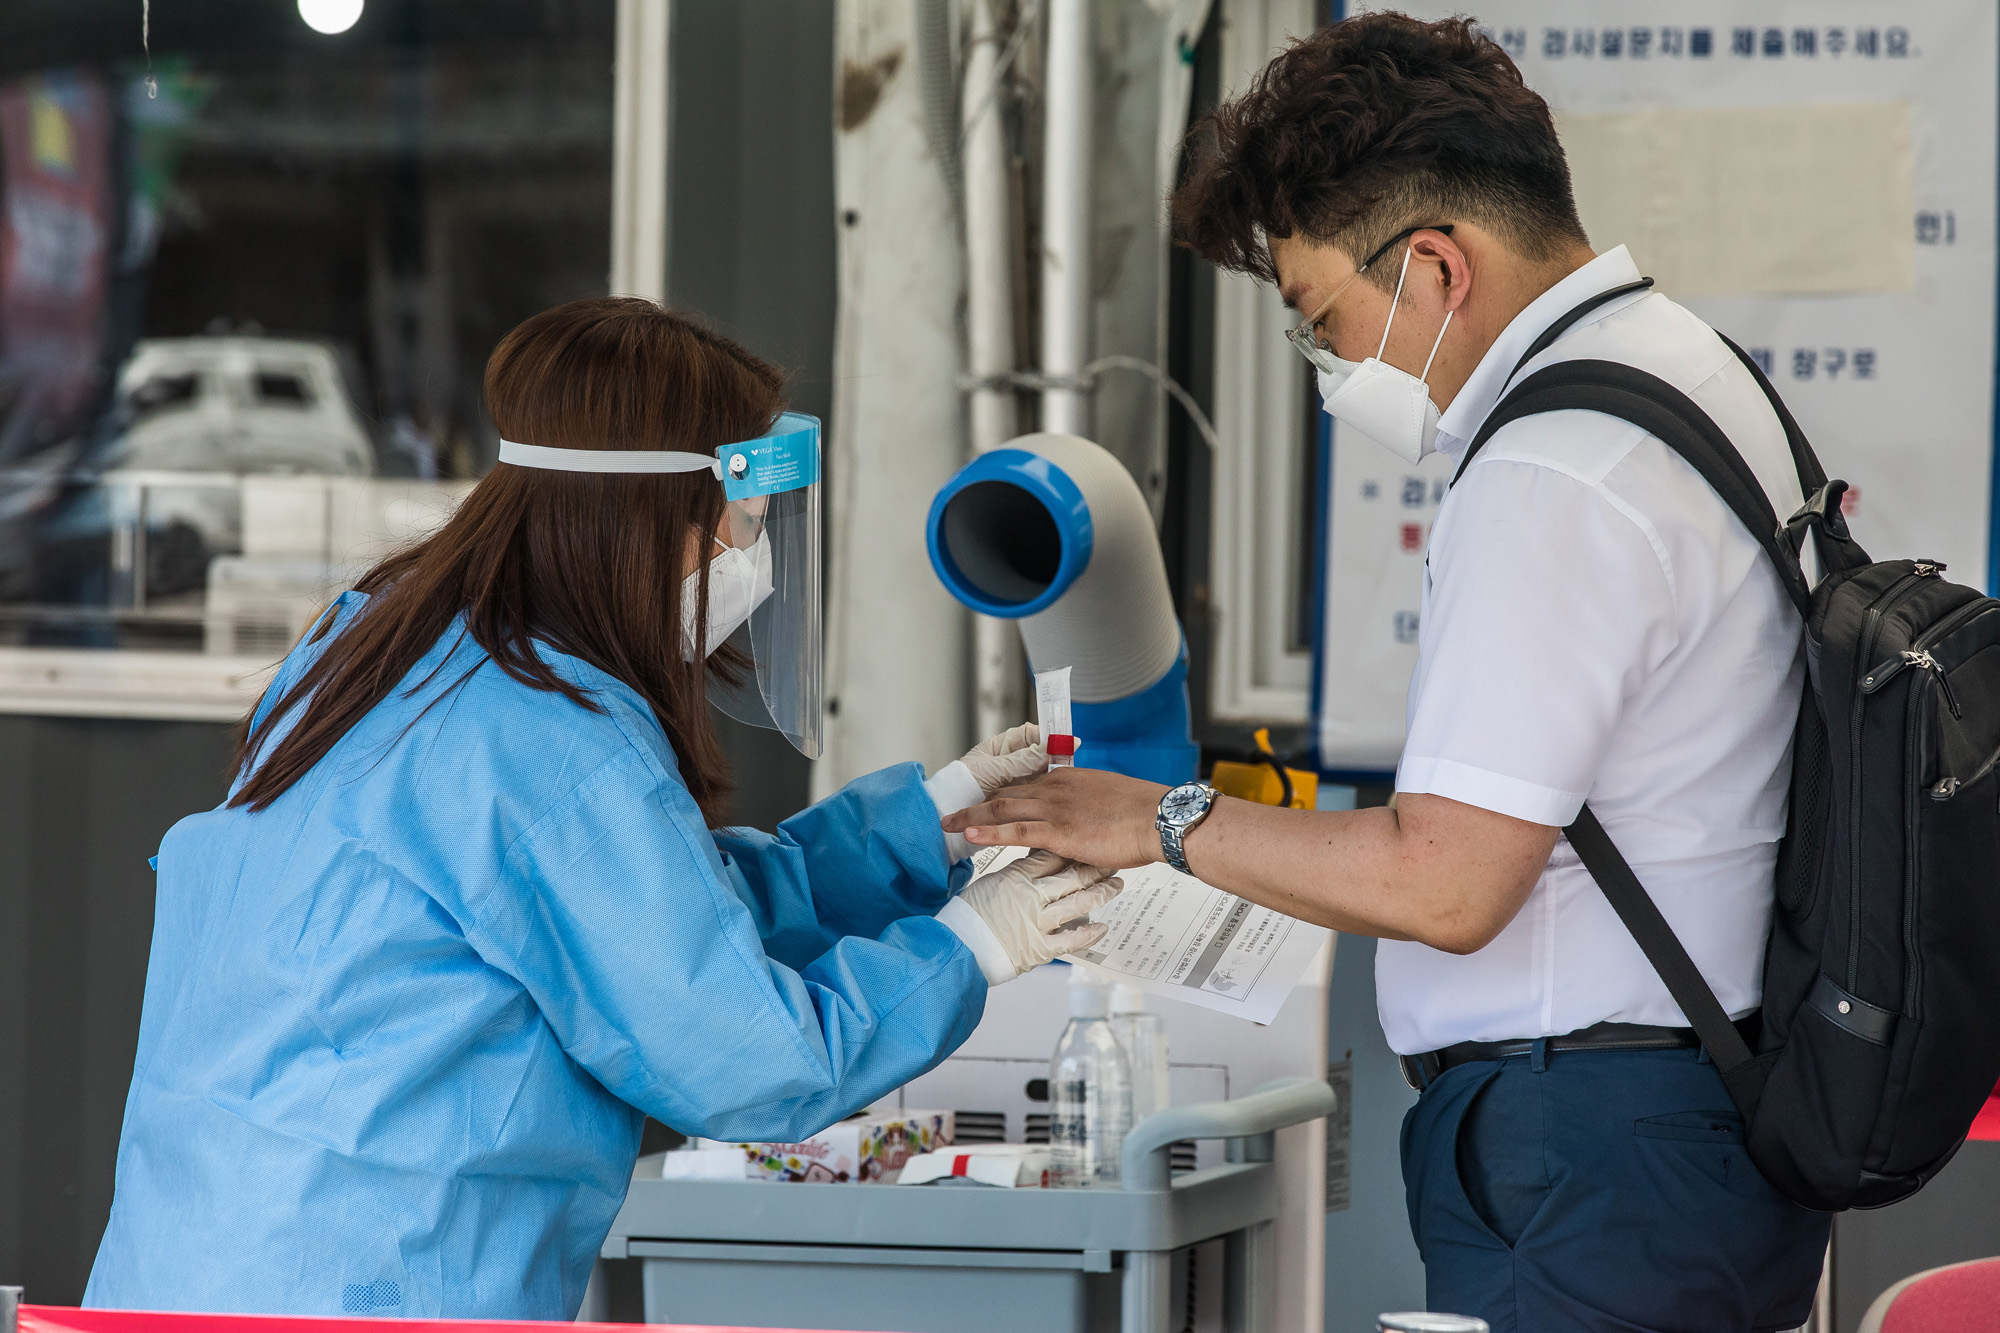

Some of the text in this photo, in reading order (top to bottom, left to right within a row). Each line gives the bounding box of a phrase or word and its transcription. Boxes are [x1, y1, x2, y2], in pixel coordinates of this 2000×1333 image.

[1542, 26, 1713, 58] 검사설문지를
[1186, 947, 1197, 956] 가장
[1192, 933, 1206, 946] 정확한
[1218, 896, 1229, 906] PCR
[1218, 902, 1248, 941] 비인두도말 PCR법
